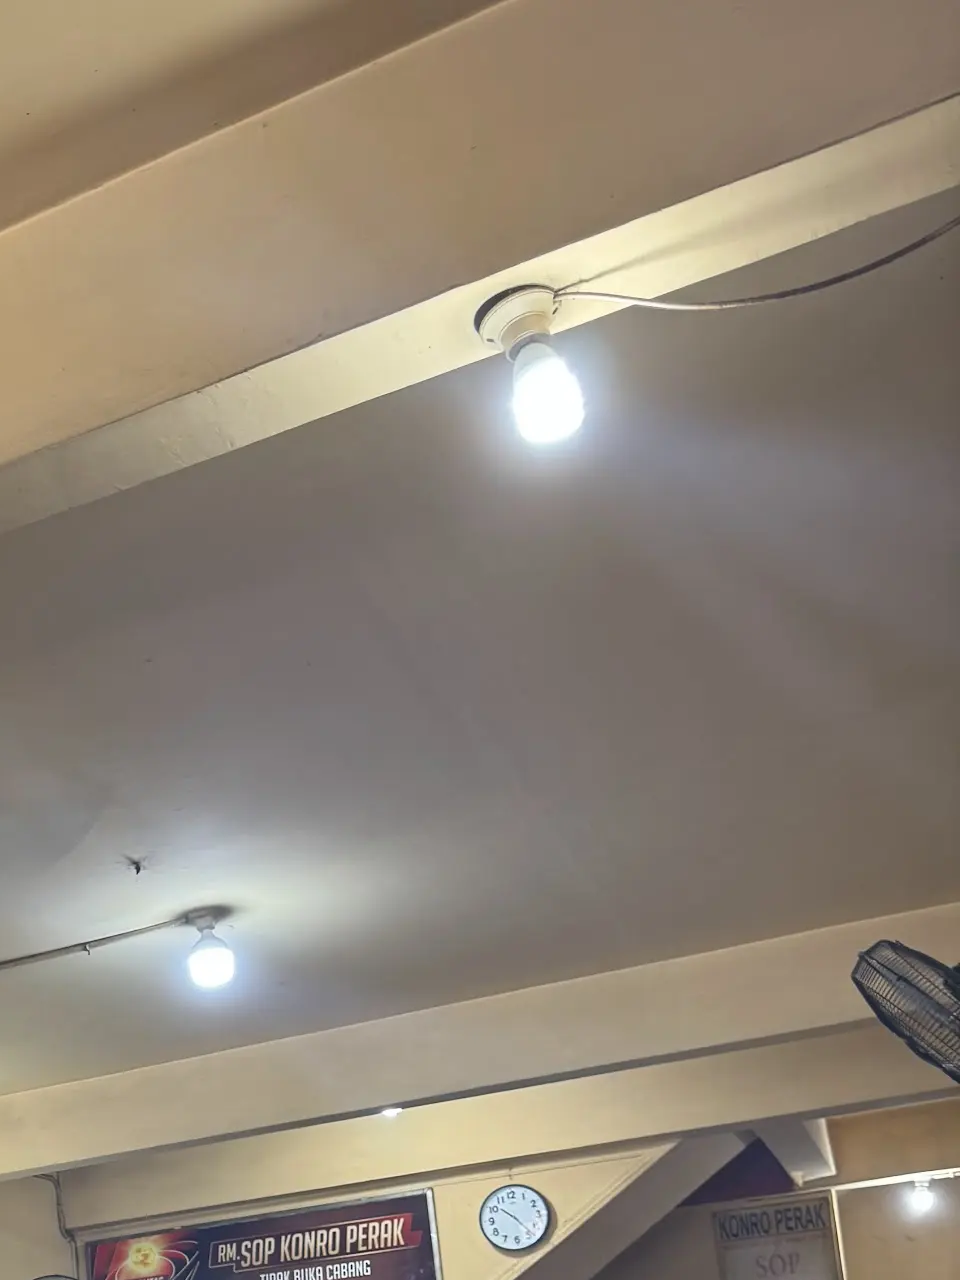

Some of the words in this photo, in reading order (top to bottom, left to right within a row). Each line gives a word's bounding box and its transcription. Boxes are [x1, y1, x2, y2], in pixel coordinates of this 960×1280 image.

[718, 1210, 770, 1241] KONRO
[774, 1203, 826, 1232] PERAK
[280, 1228, 340, 1262] KONRO
[346, 1217, 405, 1253] PERAK
[326, 1259, 371, 1280] CABANG
[754, 1251, 801, 1279] SOP
